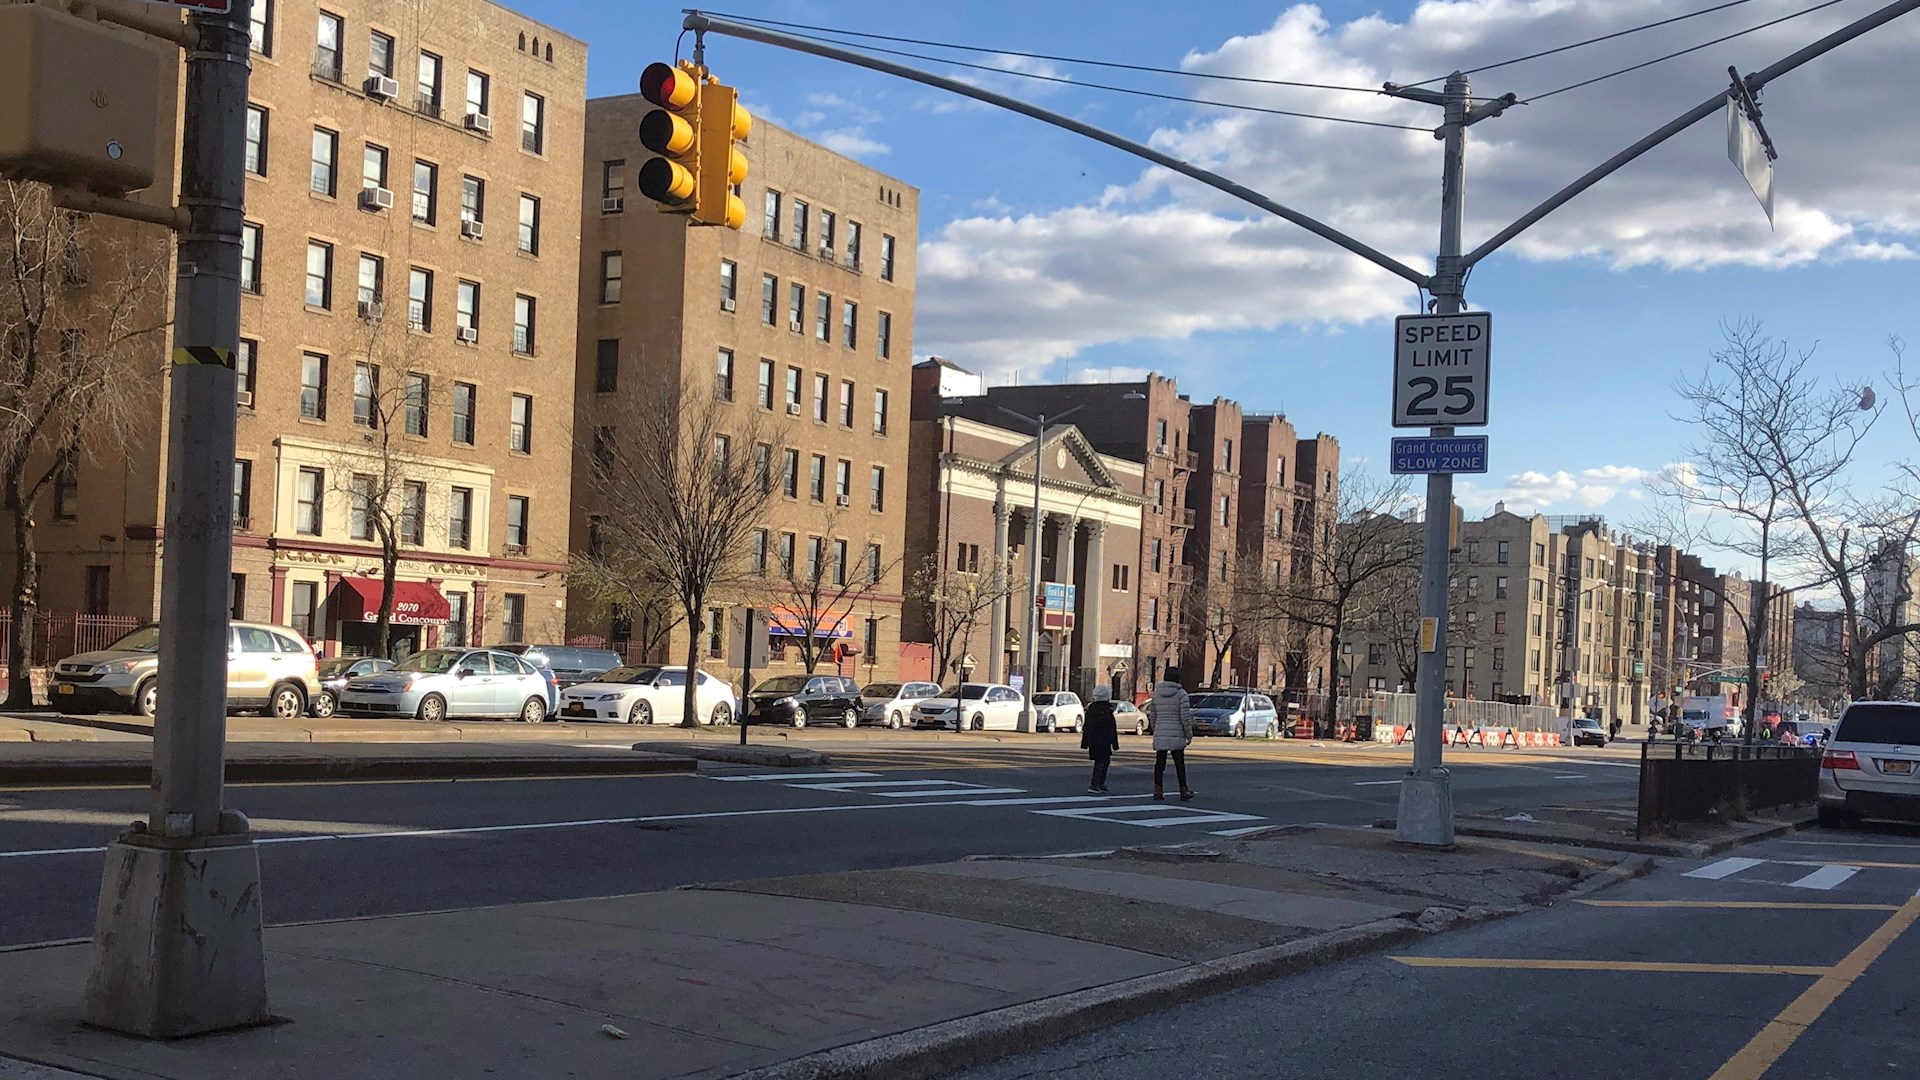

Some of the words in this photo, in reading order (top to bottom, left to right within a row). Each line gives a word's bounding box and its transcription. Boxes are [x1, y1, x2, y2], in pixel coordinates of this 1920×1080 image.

[1405, 324, 1481, 344] SPEED
[1413, 348, 1473, 367] LIMIT
[1406, 375, 1476, 416] 25
[1396, 442, 1426, 454] Grand
[1430, 442, 1484, 454] Concourse
[1398, 457, 1437, 469] SLOW
[1441, 457, 1481, 468] ZONE
[397, 561, 420, 571] ARMS
[396, 602, 419, 612] 2070
[364, 611, 396, 622] Grd
[398, 613, 450, 625] Concourse
